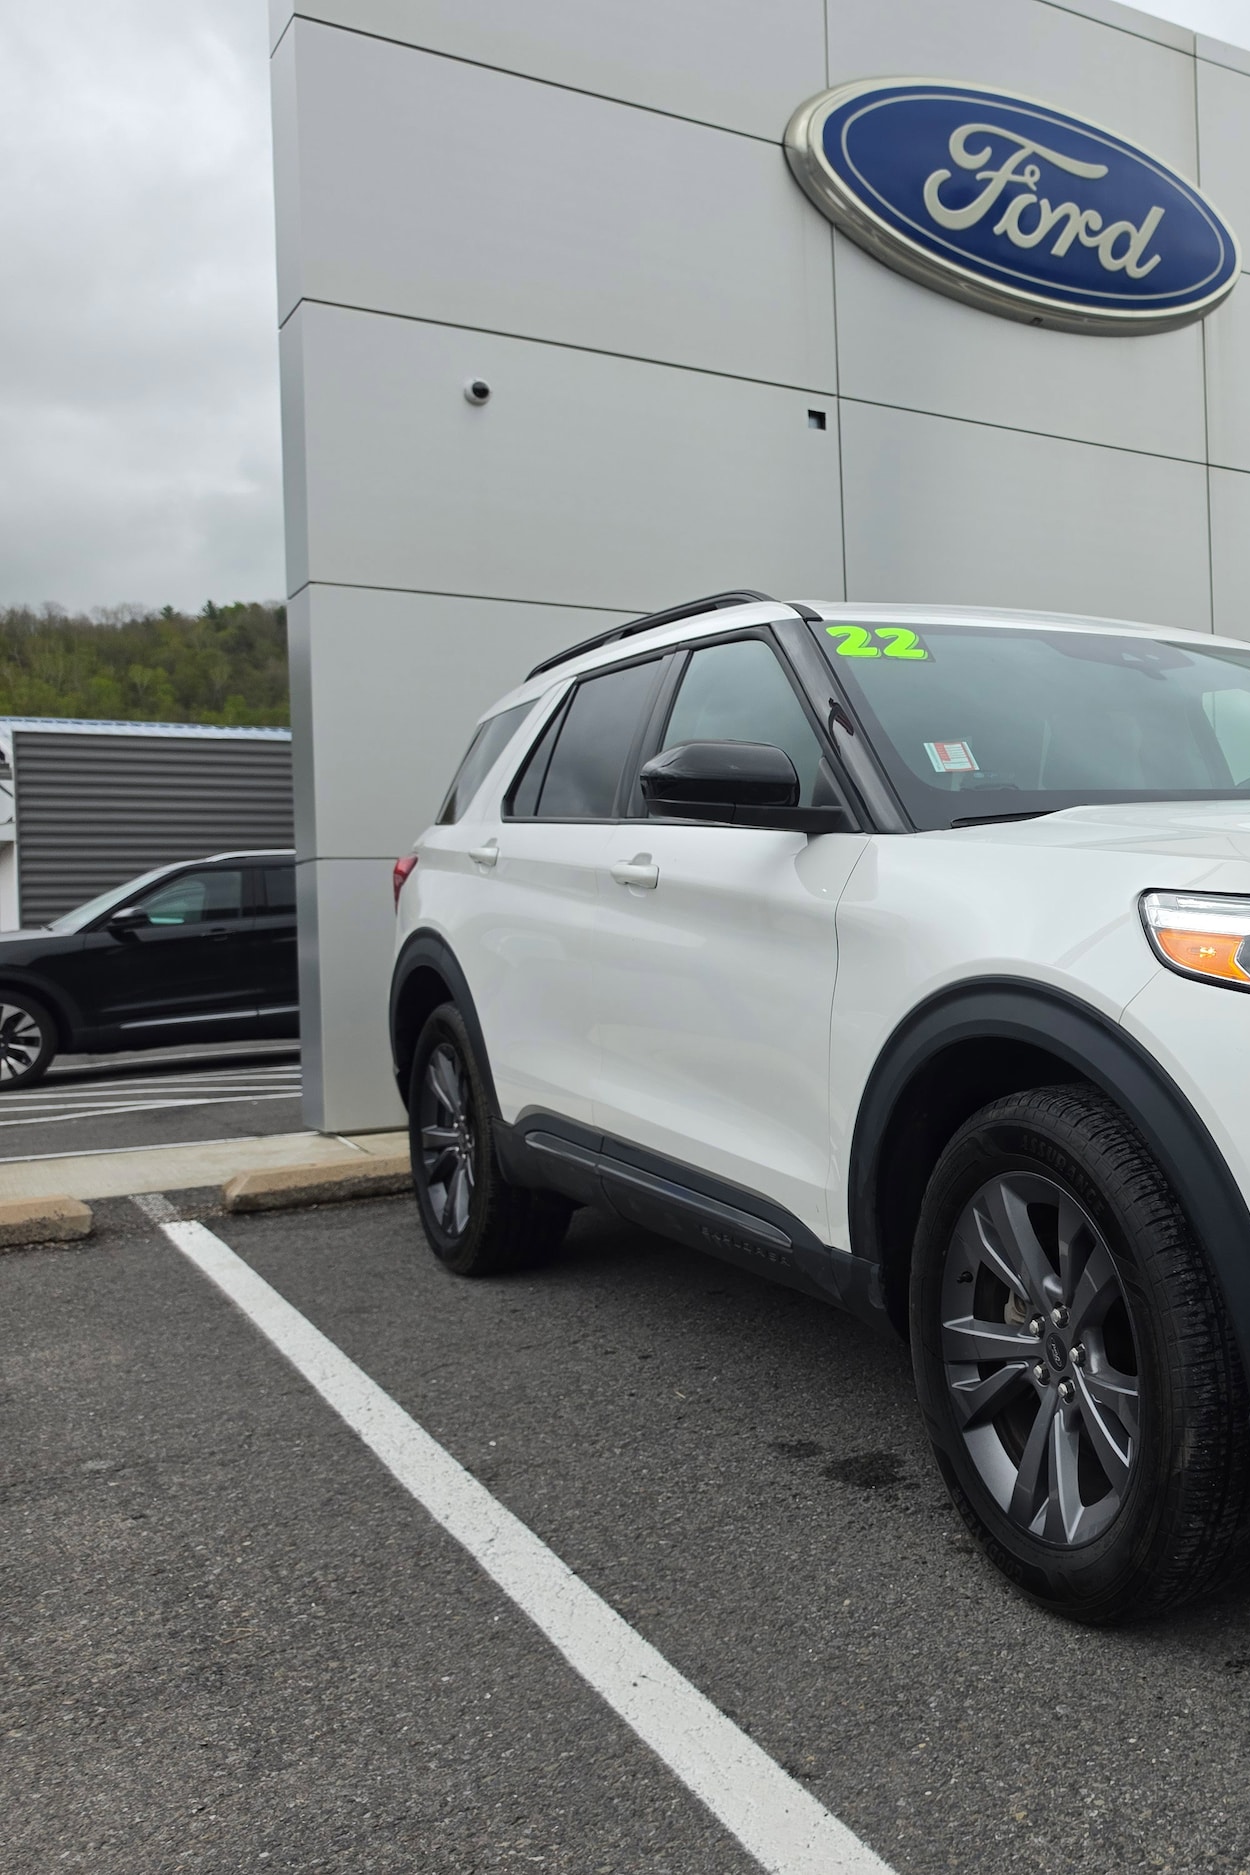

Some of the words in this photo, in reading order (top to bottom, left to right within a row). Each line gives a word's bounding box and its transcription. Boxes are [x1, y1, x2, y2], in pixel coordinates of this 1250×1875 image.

[923, 123, 1165, 278] Ford
[825, 625, 928, 660] 22
[1020, 1134, 1106, 1215] ASSURANCE
[951, 1486, 1024, 1584] GOODYEAR
